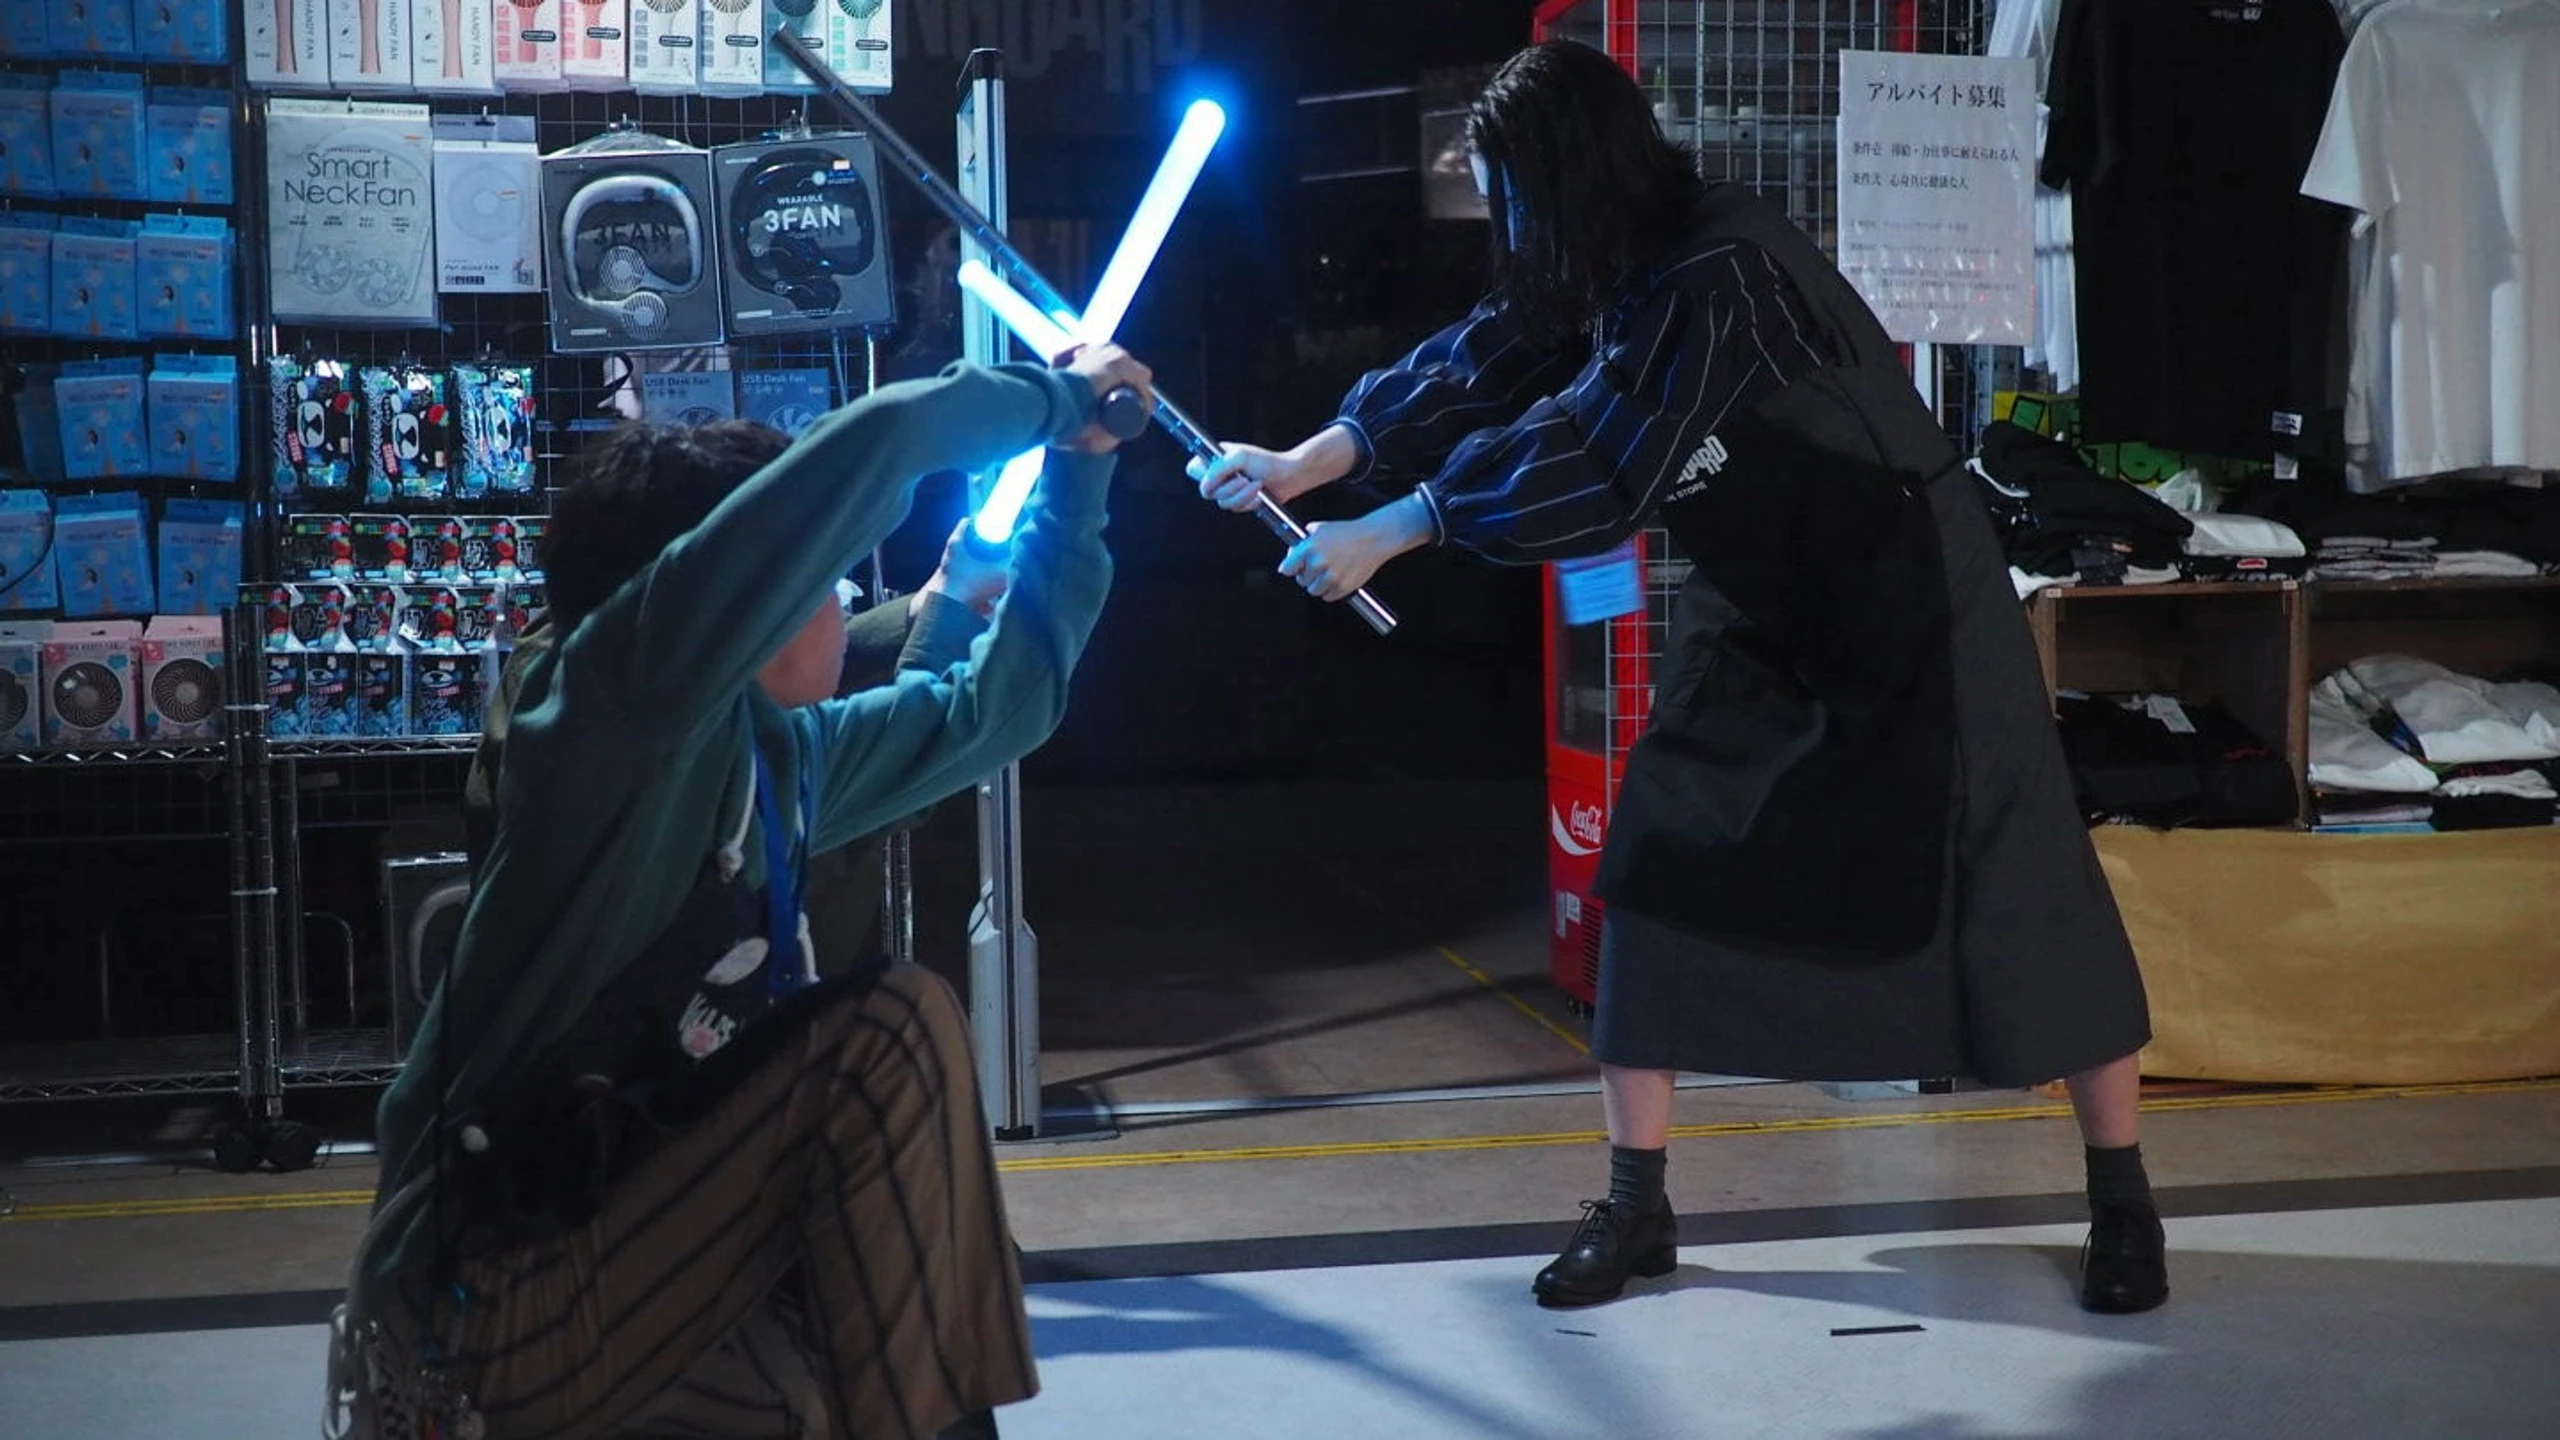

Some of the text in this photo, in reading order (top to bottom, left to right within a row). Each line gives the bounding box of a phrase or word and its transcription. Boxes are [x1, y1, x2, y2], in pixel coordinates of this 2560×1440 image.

[1867, 82, 2006, 108] アルバイト募集
[306, 152, 391, 180] Smart
[777, 194, 824, 207] WEARABLE
[764, 204, 841, 233] 3FAN
